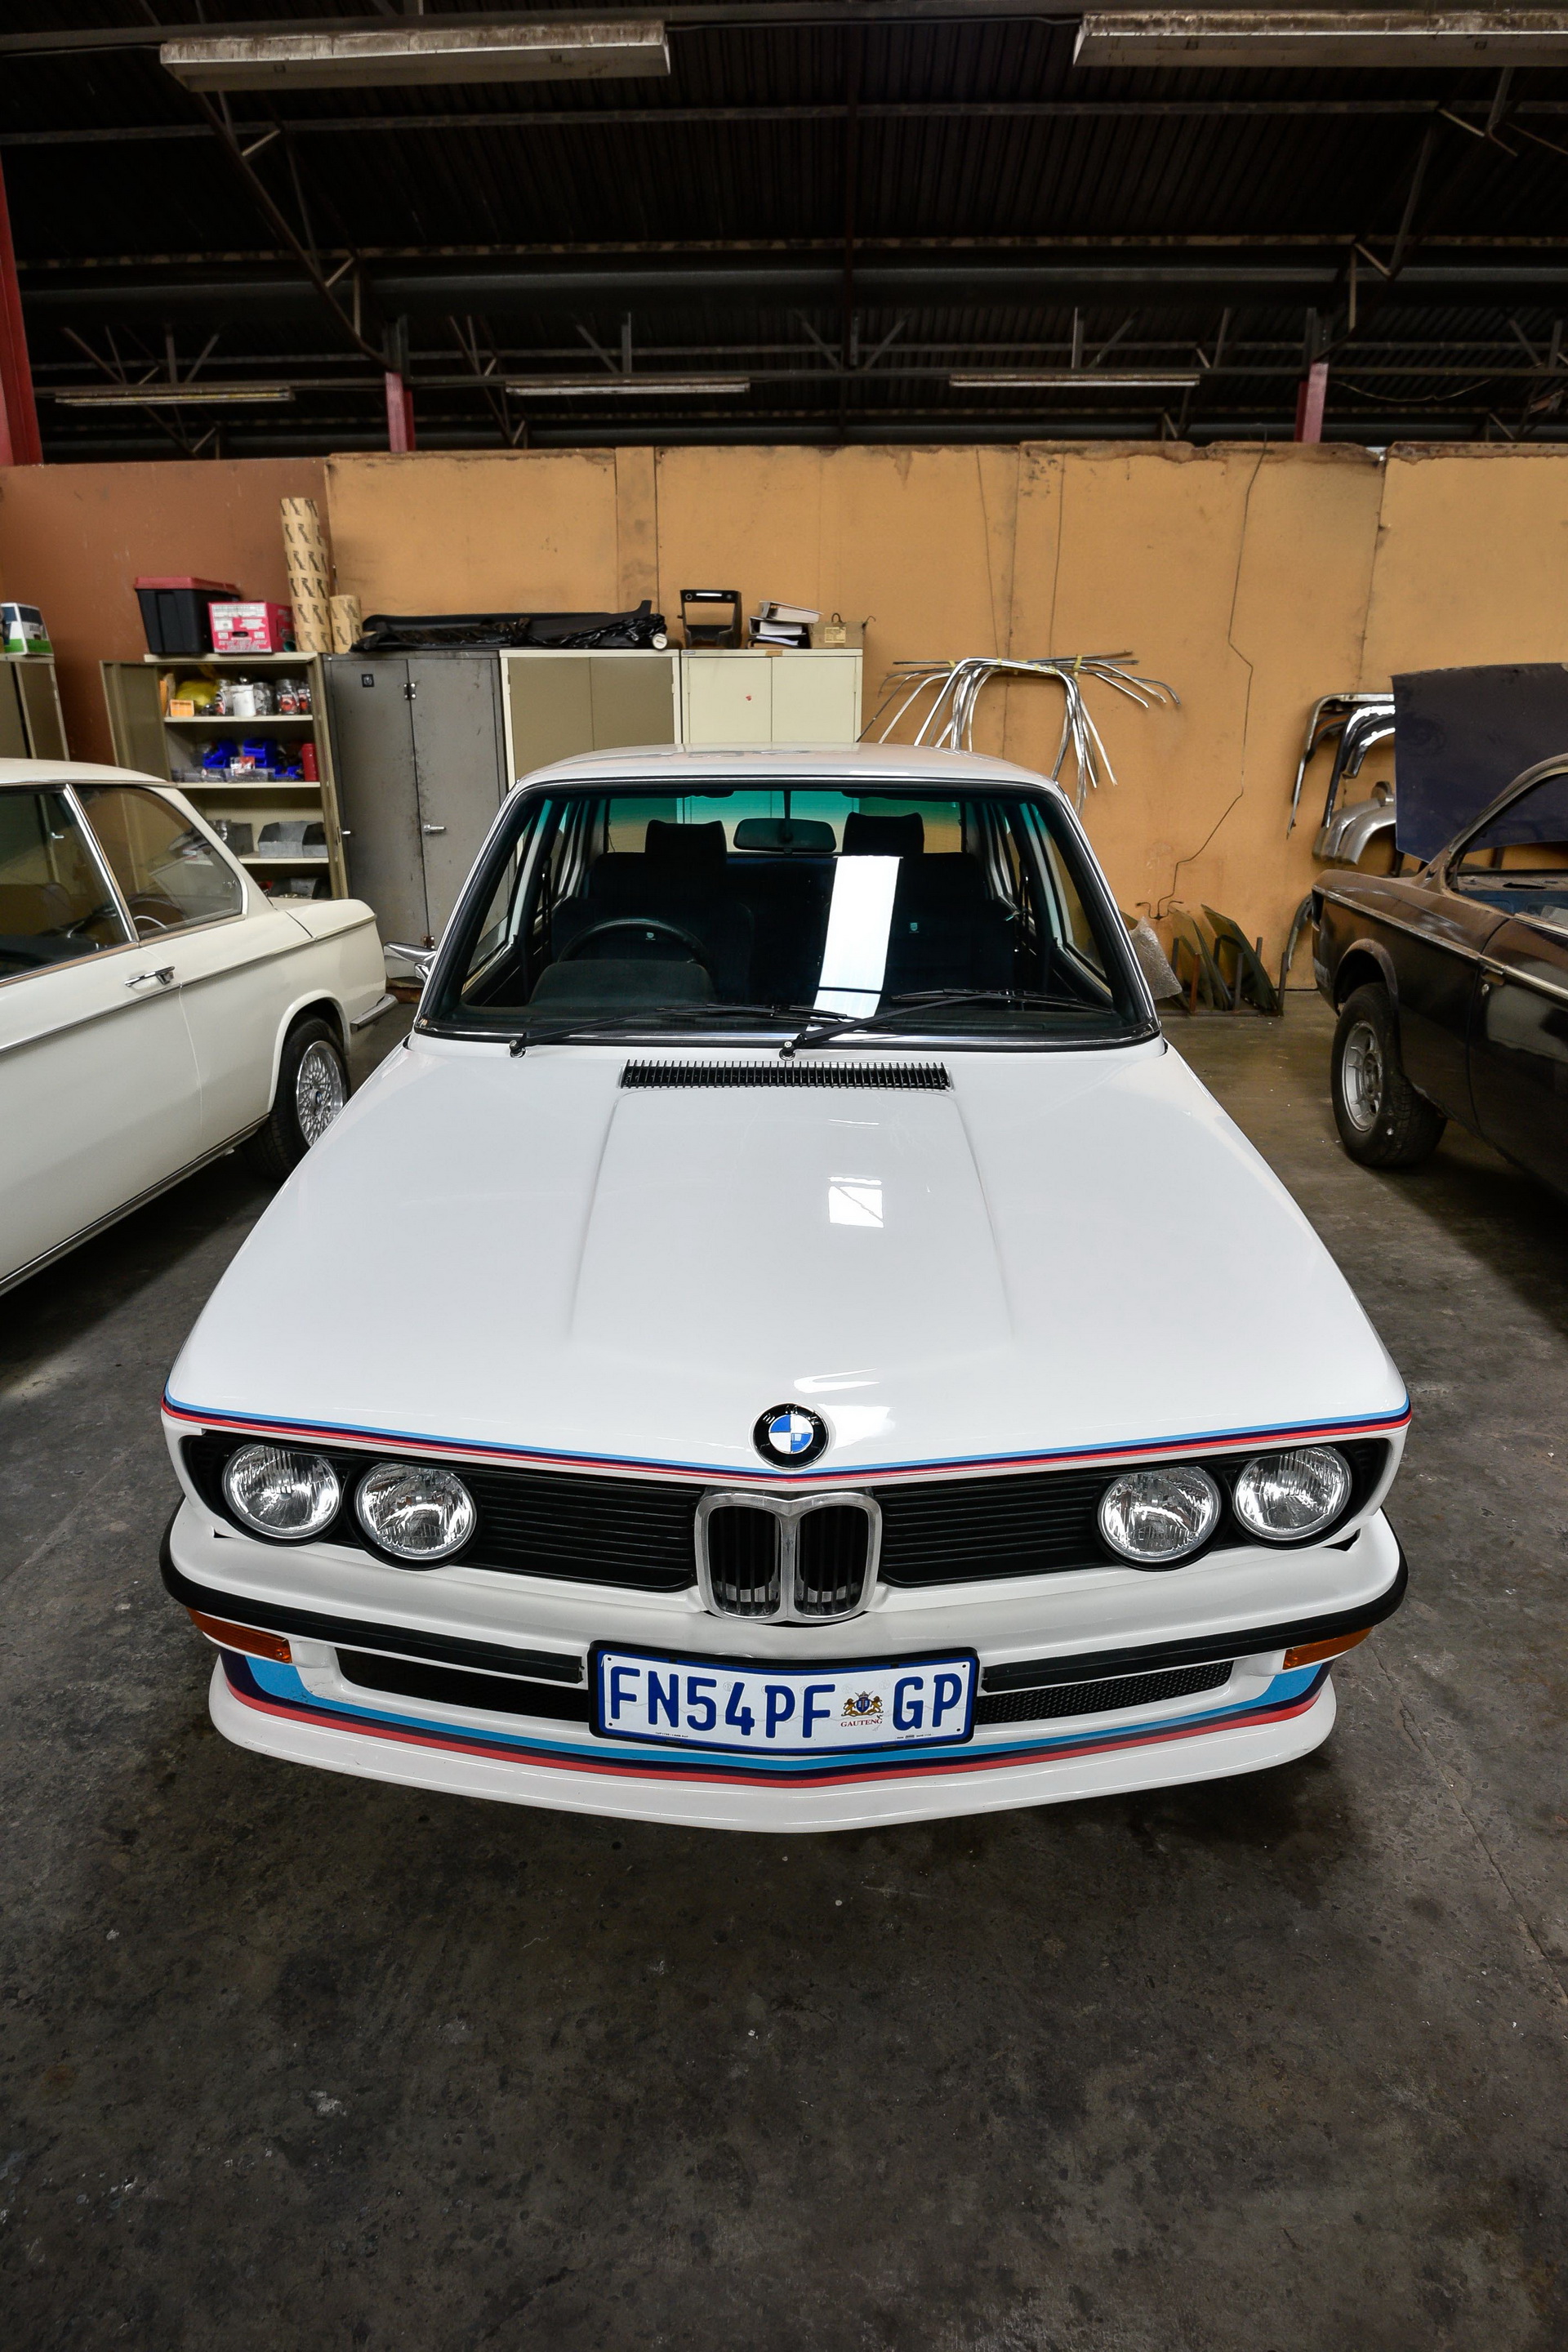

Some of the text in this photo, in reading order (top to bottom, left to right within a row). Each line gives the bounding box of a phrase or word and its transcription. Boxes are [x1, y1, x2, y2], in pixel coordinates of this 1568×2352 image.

[610, 1665, 964, 1739] FN54PF GP
[840, 1718, 883, 1727] GAUTENG
